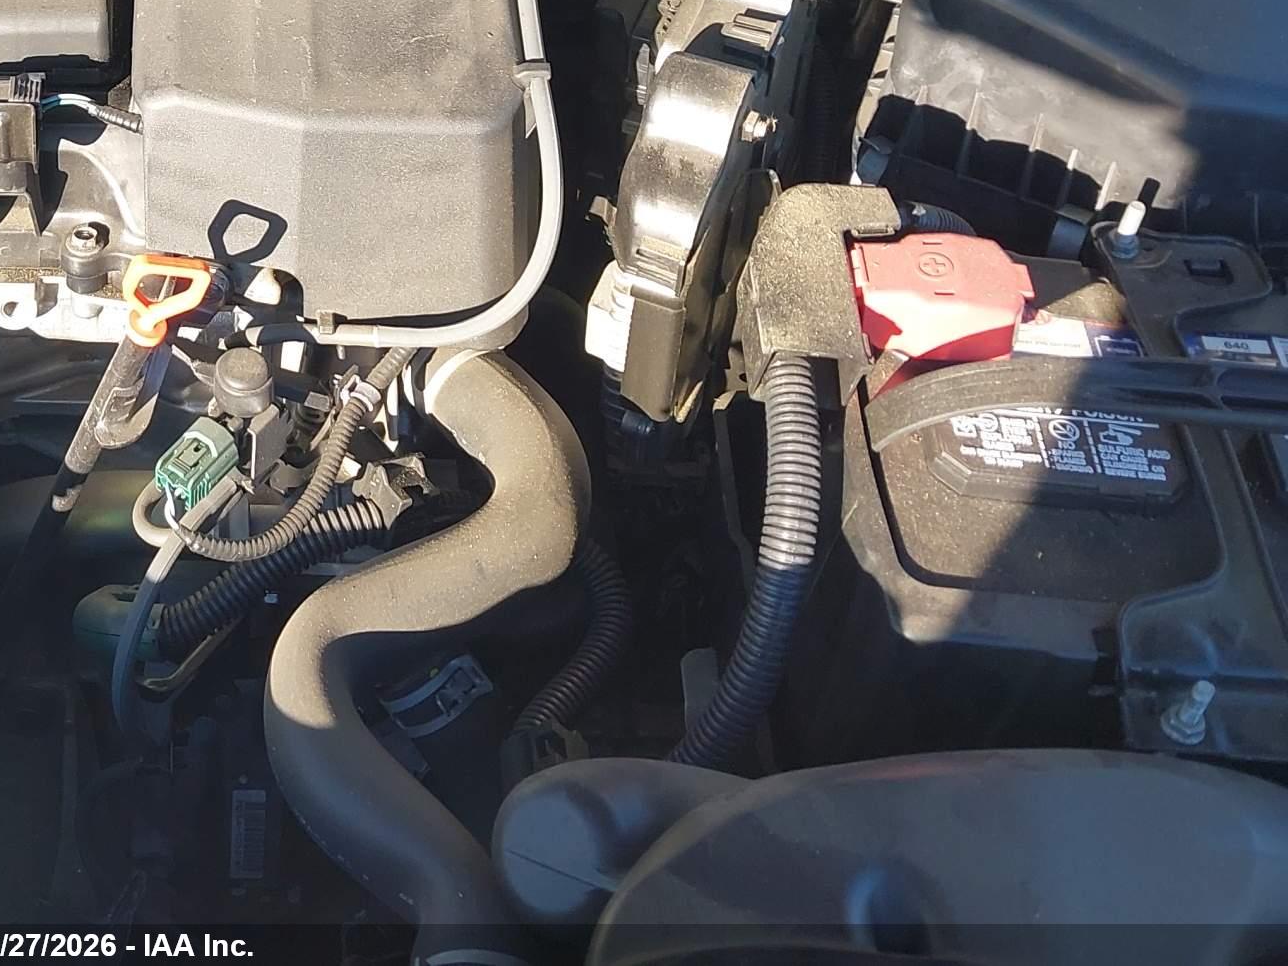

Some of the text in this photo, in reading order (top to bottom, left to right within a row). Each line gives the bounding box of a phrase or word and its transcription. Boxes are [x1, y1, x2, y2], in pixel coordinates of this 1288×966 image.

[1223, 341, 1249, 350] 640
[1058, 440, 1075, 450] NO
[1097, 444, 1171, 460] SULFURIC ACID
